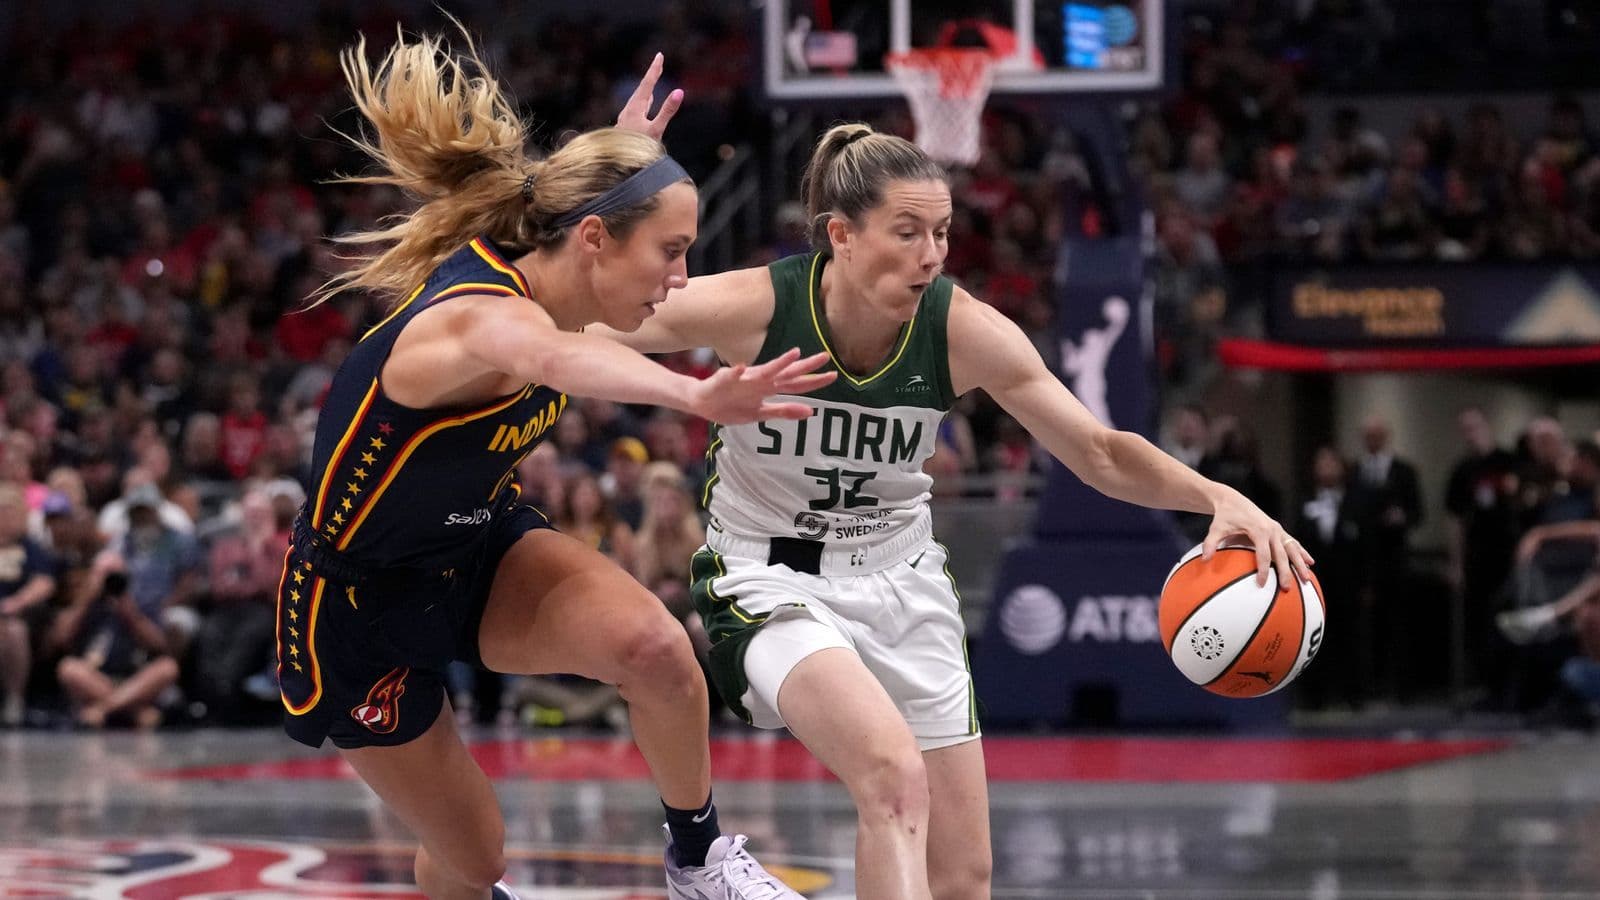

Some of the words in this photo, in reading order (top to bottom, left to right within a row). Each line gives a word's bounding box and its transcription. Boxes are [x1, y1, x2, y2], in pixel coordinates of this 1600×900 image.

[1294, 282, 1444, 316] Elevance
[896, 384, 931, 393] SYMETRA
[757, 408, 922, 464] STORM
[804, 467, 879, 510] 32
[1069, 596, 1159, 643] AT&
